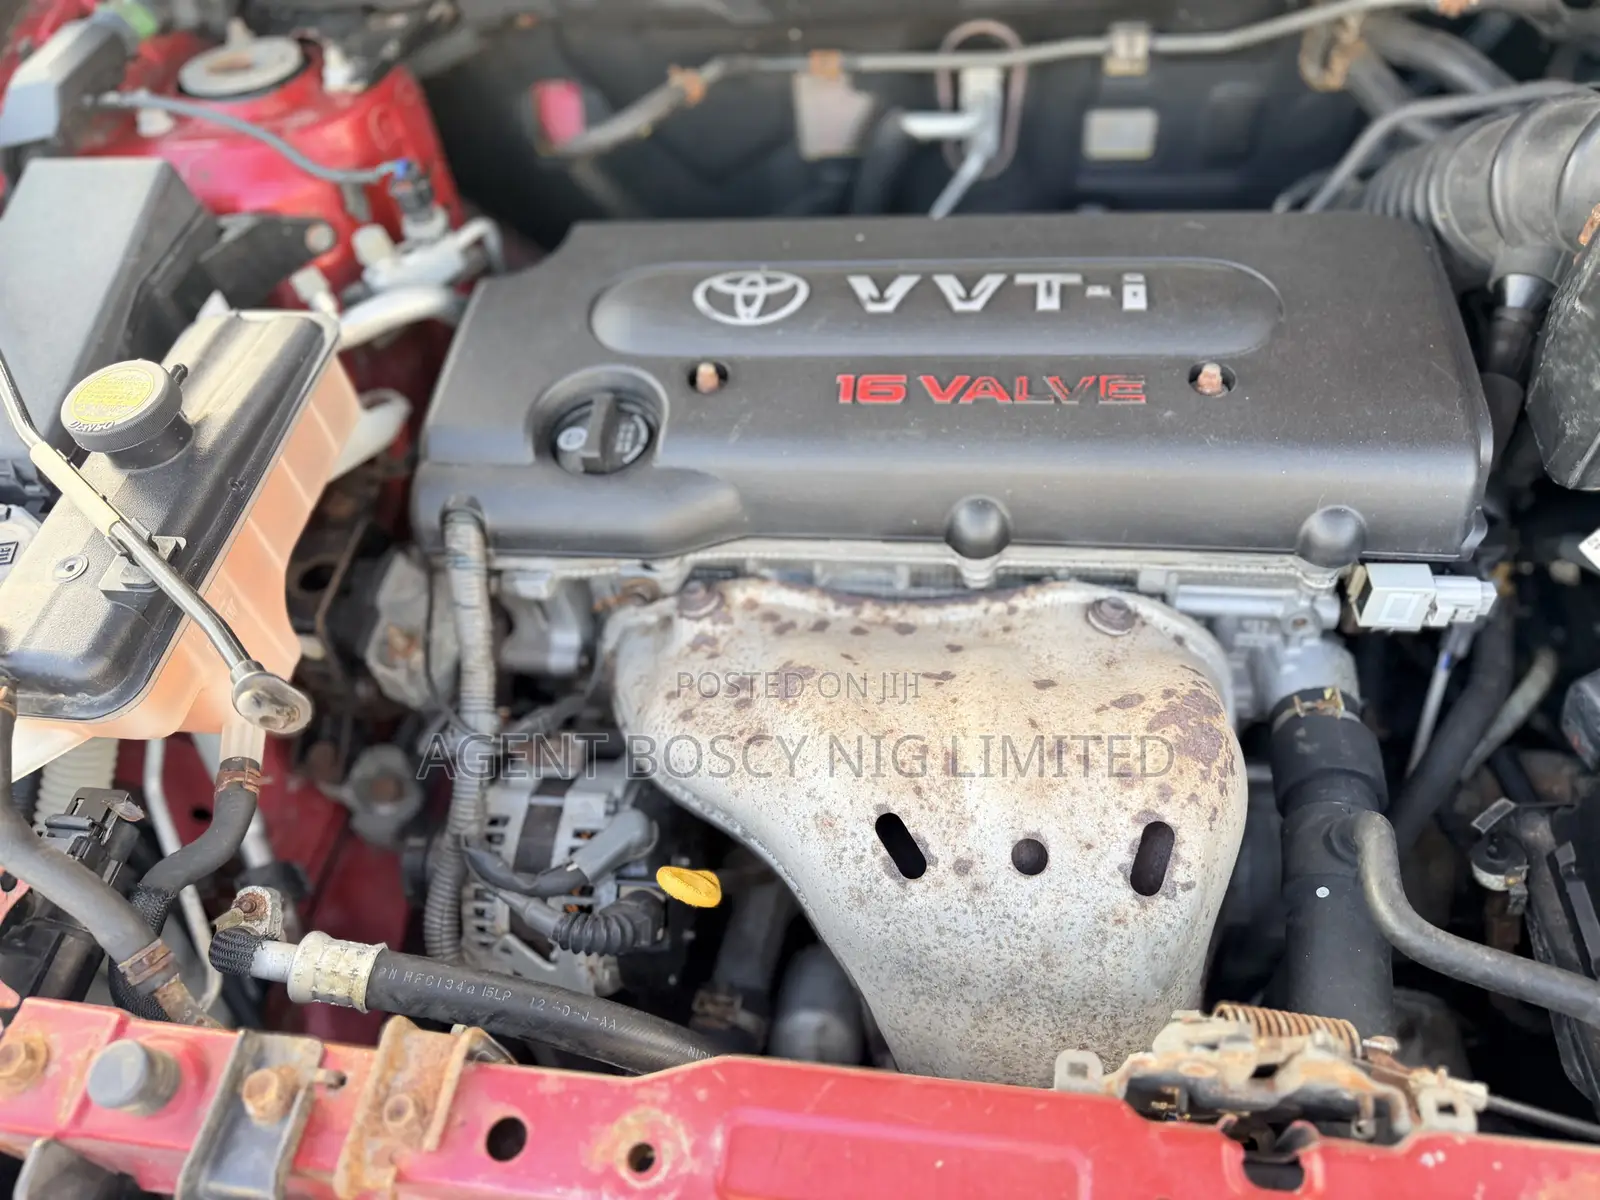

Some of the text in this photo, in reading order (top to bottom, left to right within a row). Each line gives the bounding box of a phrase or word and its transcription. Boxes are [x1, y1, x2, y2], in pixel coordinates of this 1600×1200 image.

[847, 273, 1149, 313] VVT-i
[836, 374, 1147, 405] 16 VALVE
[69, 420, 117, 433] DENSO
